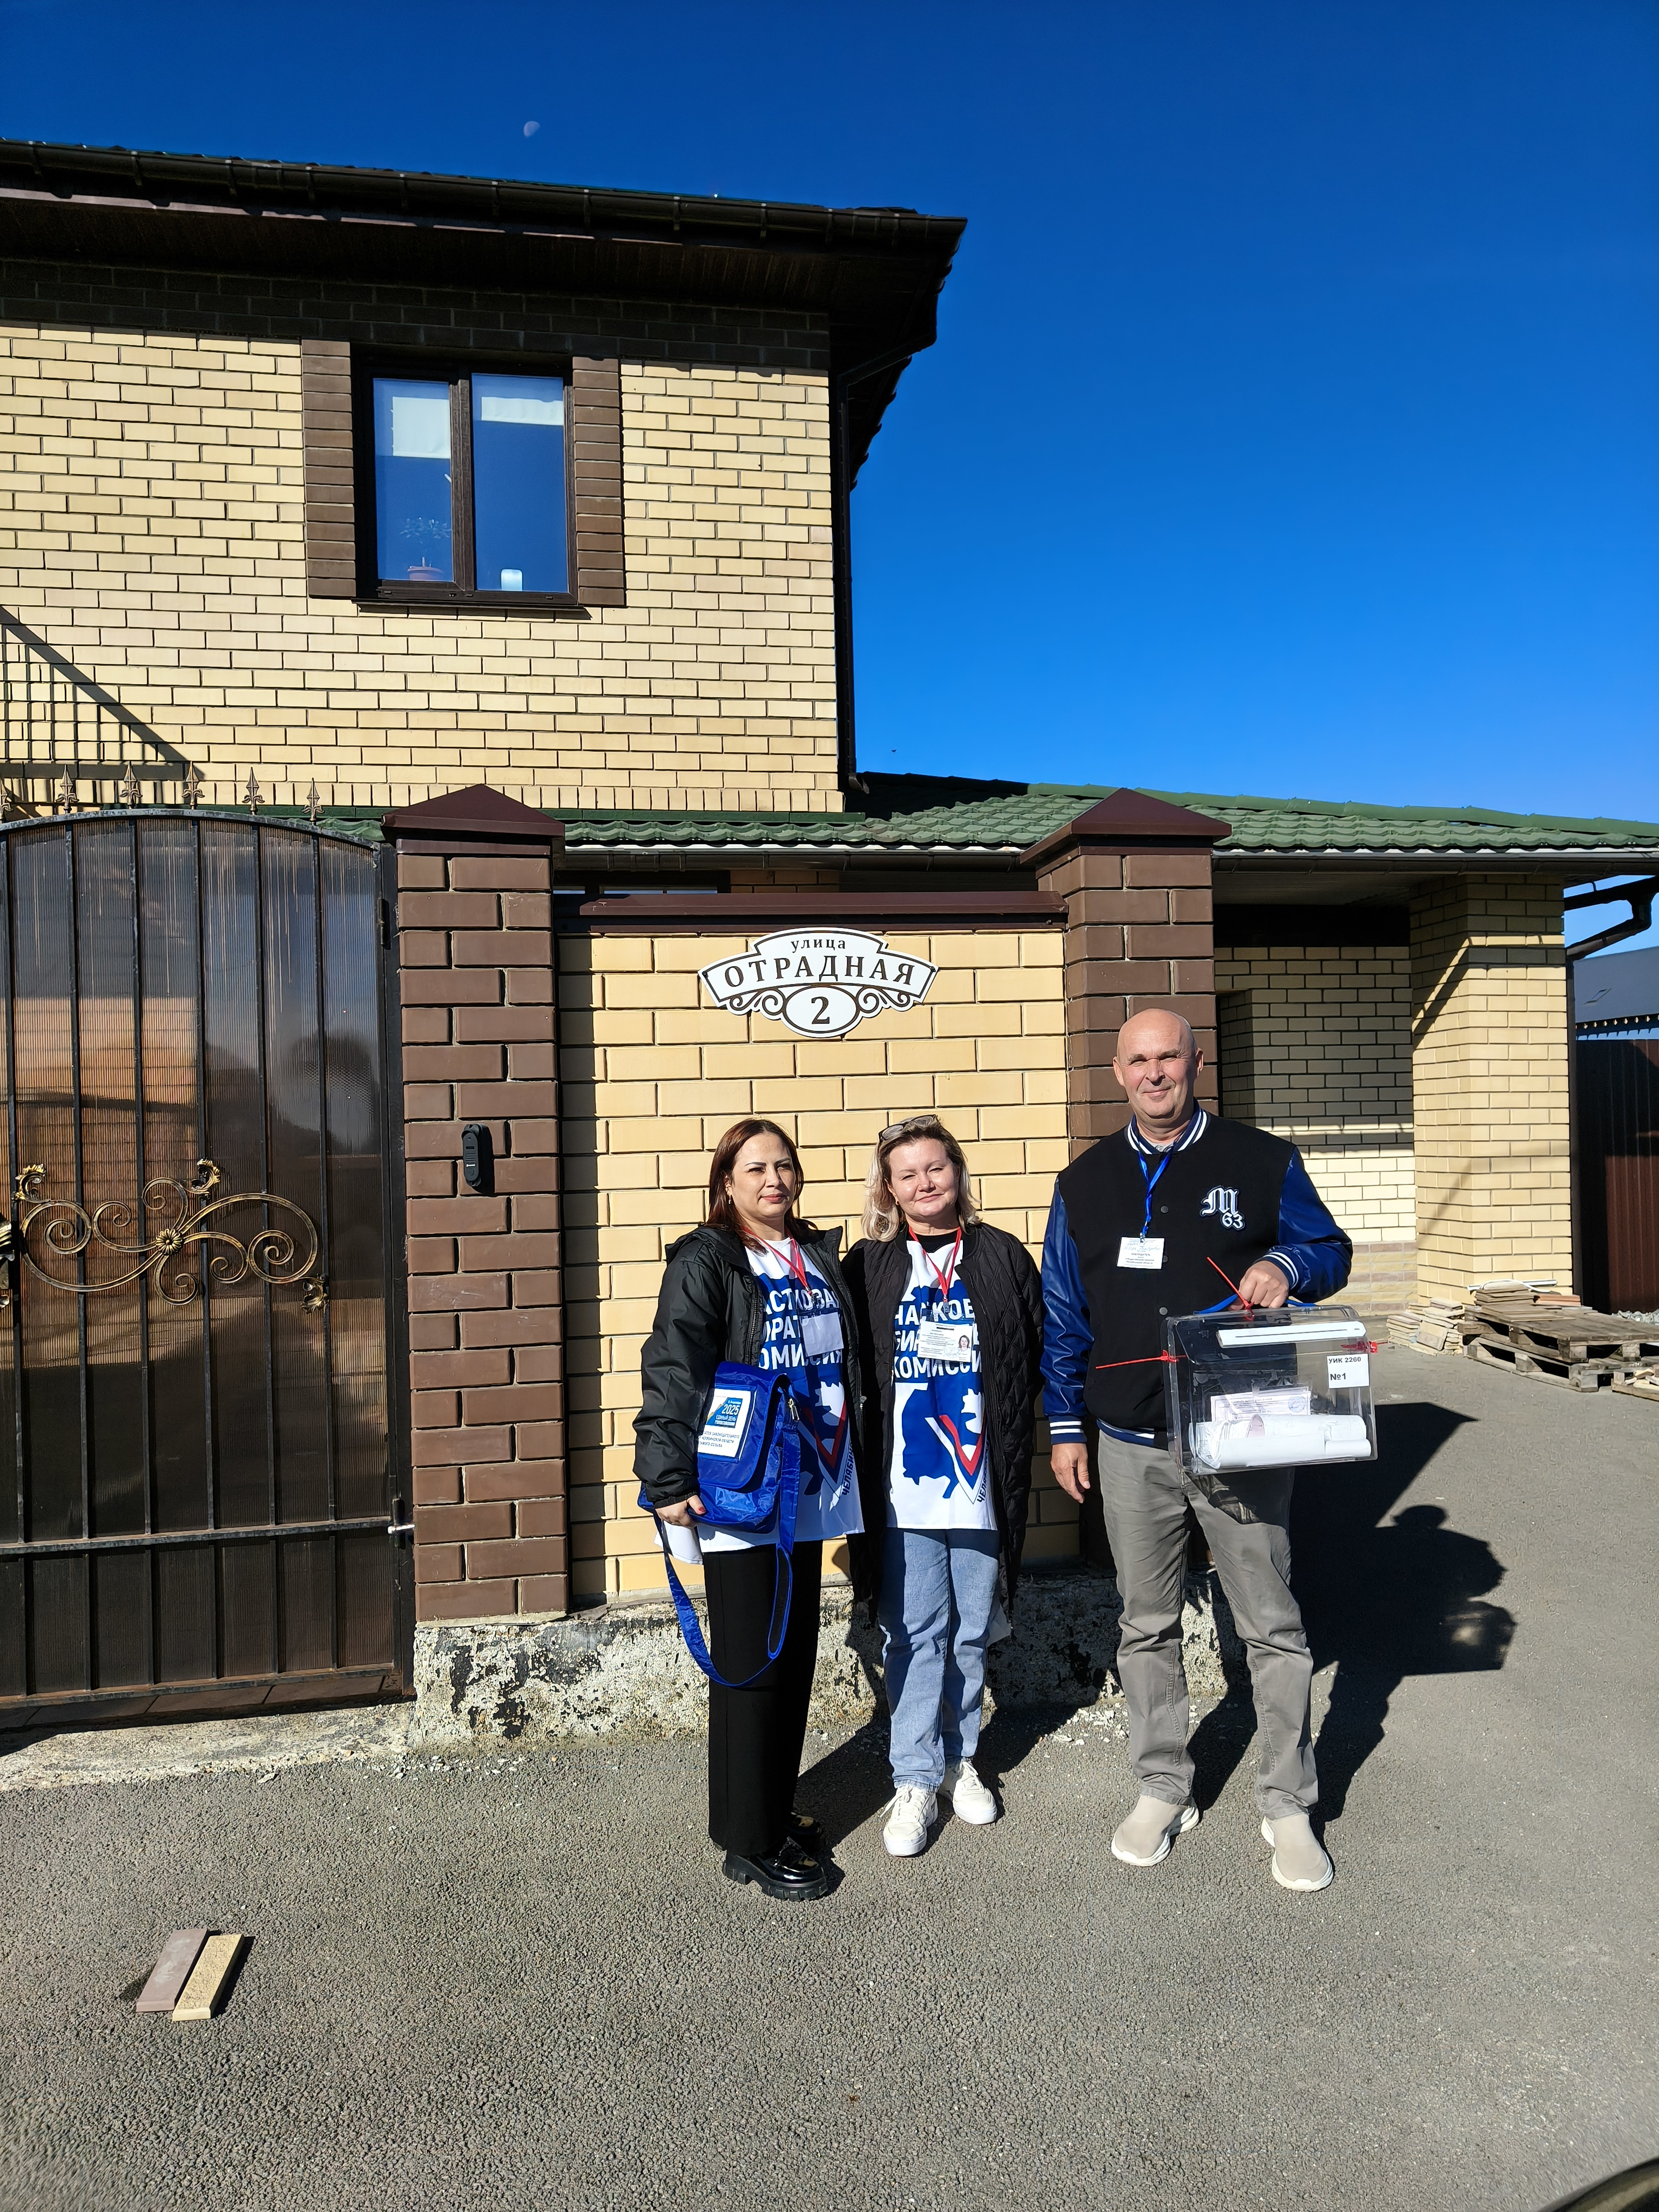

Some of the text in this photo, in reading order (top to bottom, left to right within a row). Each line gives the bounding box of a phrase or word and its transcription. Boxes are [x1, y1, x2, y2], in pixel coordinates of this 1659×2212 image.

[791, 939, 846, 953] улица
[725, 955, 915, 987] ОТРАДНАЯ
[811, 996, 830, 1024] 2
[1222, 1212, 1243, 1229] 63
[721, 1404, 740, 1415] 2025
